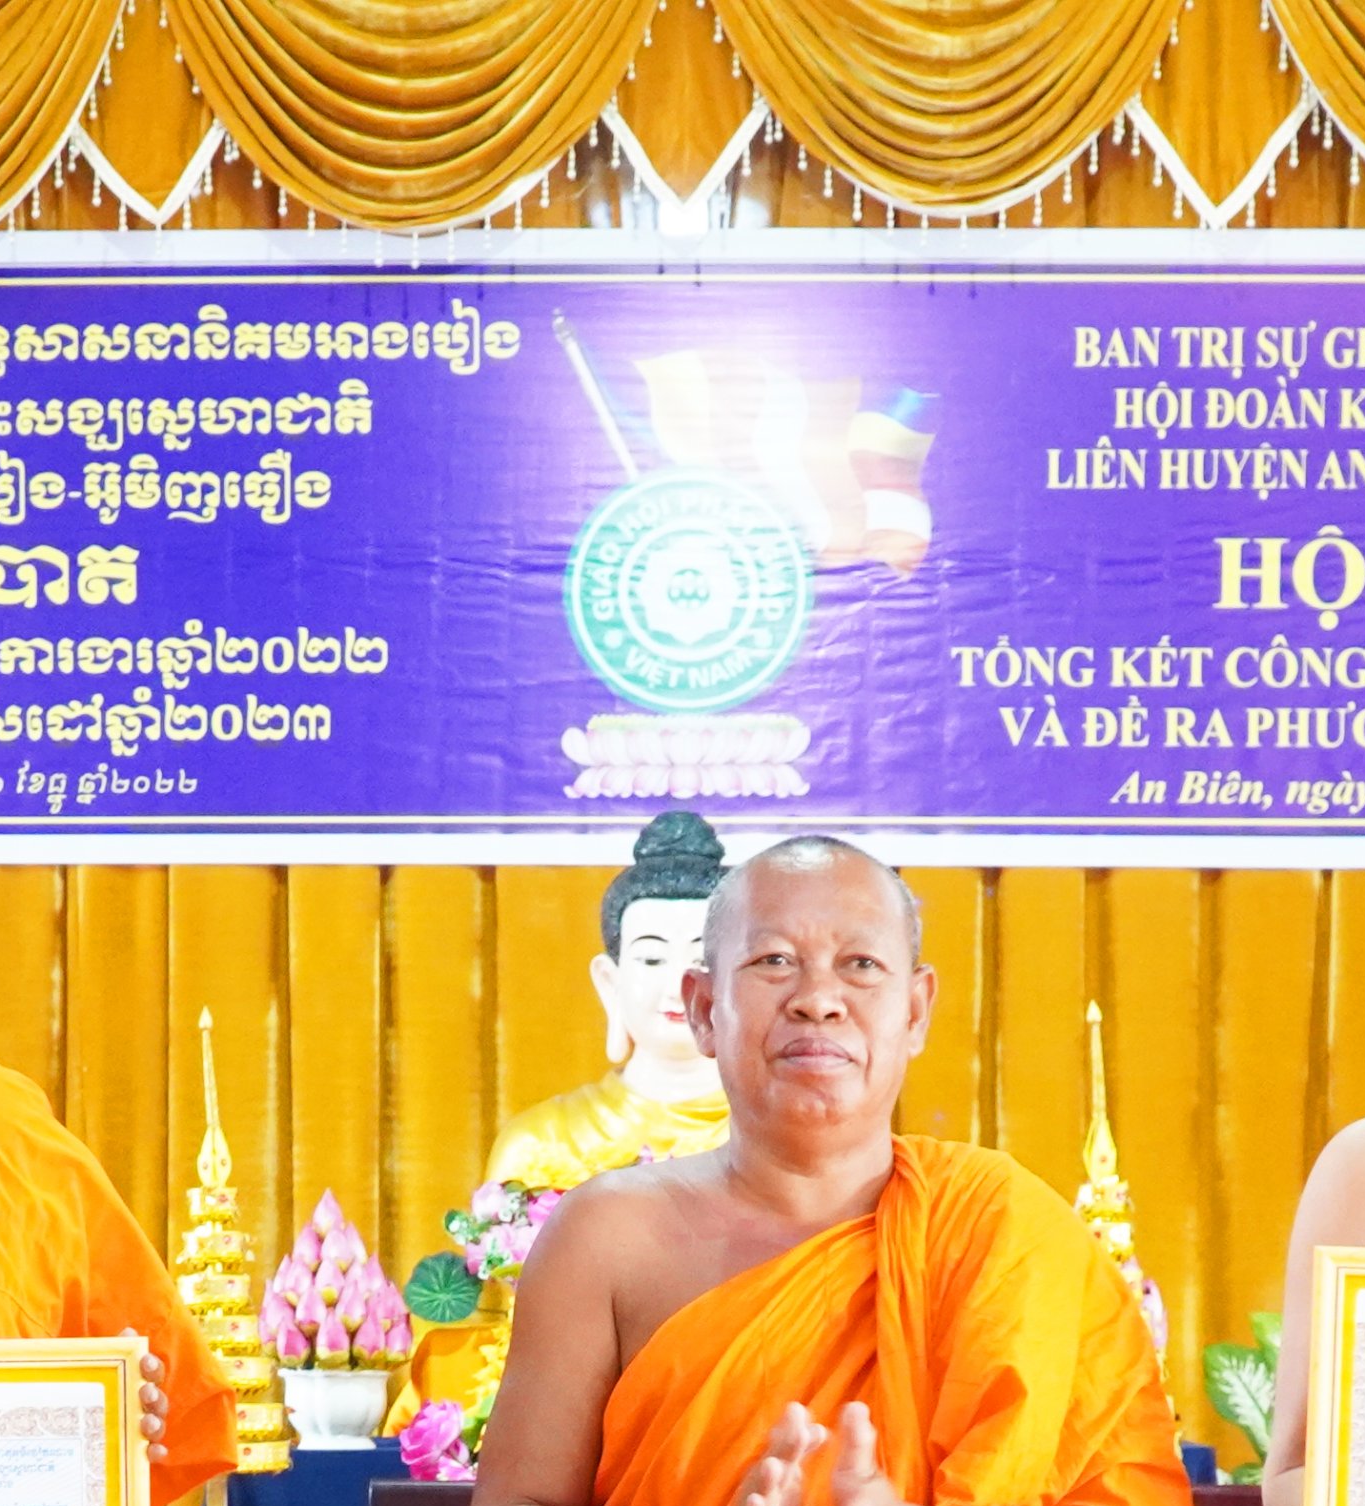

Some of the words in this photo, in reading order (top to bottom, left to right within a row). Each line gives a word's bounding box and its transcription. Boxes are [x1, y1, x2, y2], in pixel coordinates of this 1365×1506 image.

[1074, 327, 1161, 368] BAN
[1171, 327, 1246, 379] TRỊ
[1256, 321, 1316, 381] SỰ
[1114, 380, 1193, 439] HỘI
[1205, 379, 1327, 430] ĐOÀN
[1046, 436, 1147, 489] LIÊN
[1158, 441, 1308, 501] HUYỆN
[623, 646, 686, 690] VIỆT
[687, 646, 753, 690] NAM
[948, 638, 1095, 689] TỔNG
[1110, 638, 1213, 688] KẾT
[999, 695, 1070, 748] VÀ
[1081, 694, 1151, 748] ĐỀ
[1164, 708, 1234, 748] RA
[1110, 770, 1167, 805] An
[1177, 770, 1275, 811] Biên,
